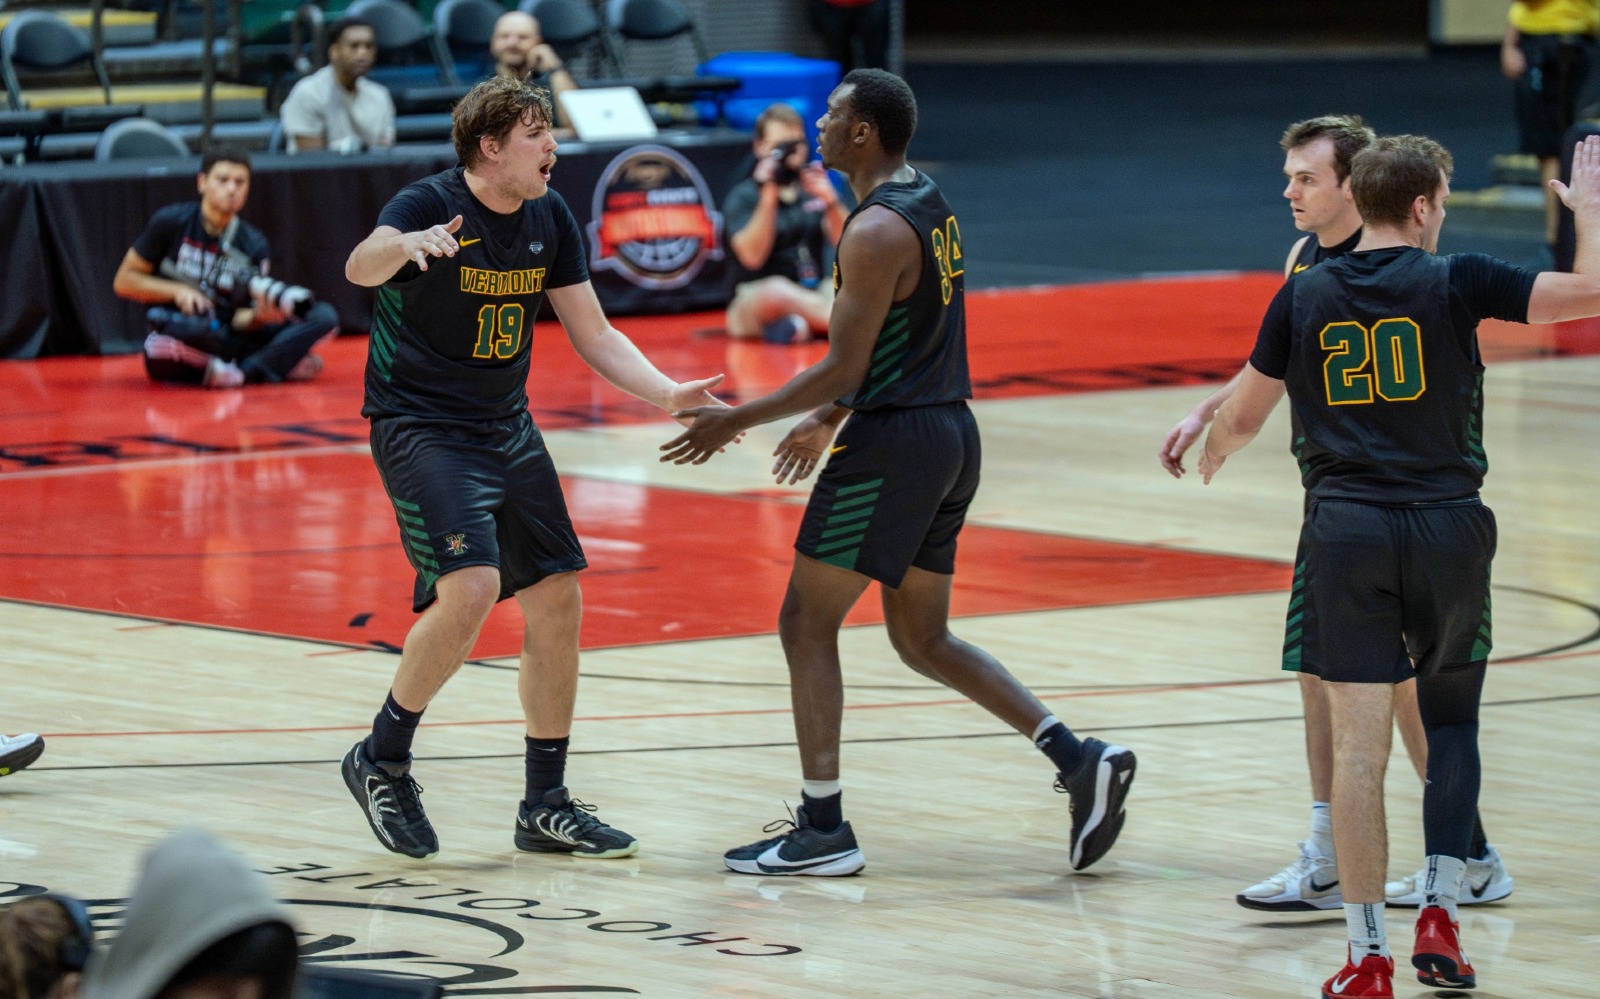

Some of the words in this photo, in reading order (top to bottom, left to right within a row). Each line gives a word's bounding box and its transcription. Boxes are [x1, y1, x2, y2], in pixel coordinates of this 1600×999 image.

[460, 266, 546, 296] VERMONT
[932, 215, 965, 305] 34
[472, 303, 525, 359] 19
[1319, 316, 1427, 406] 20
[254, 862, 803, 957] CHOCOLATE
